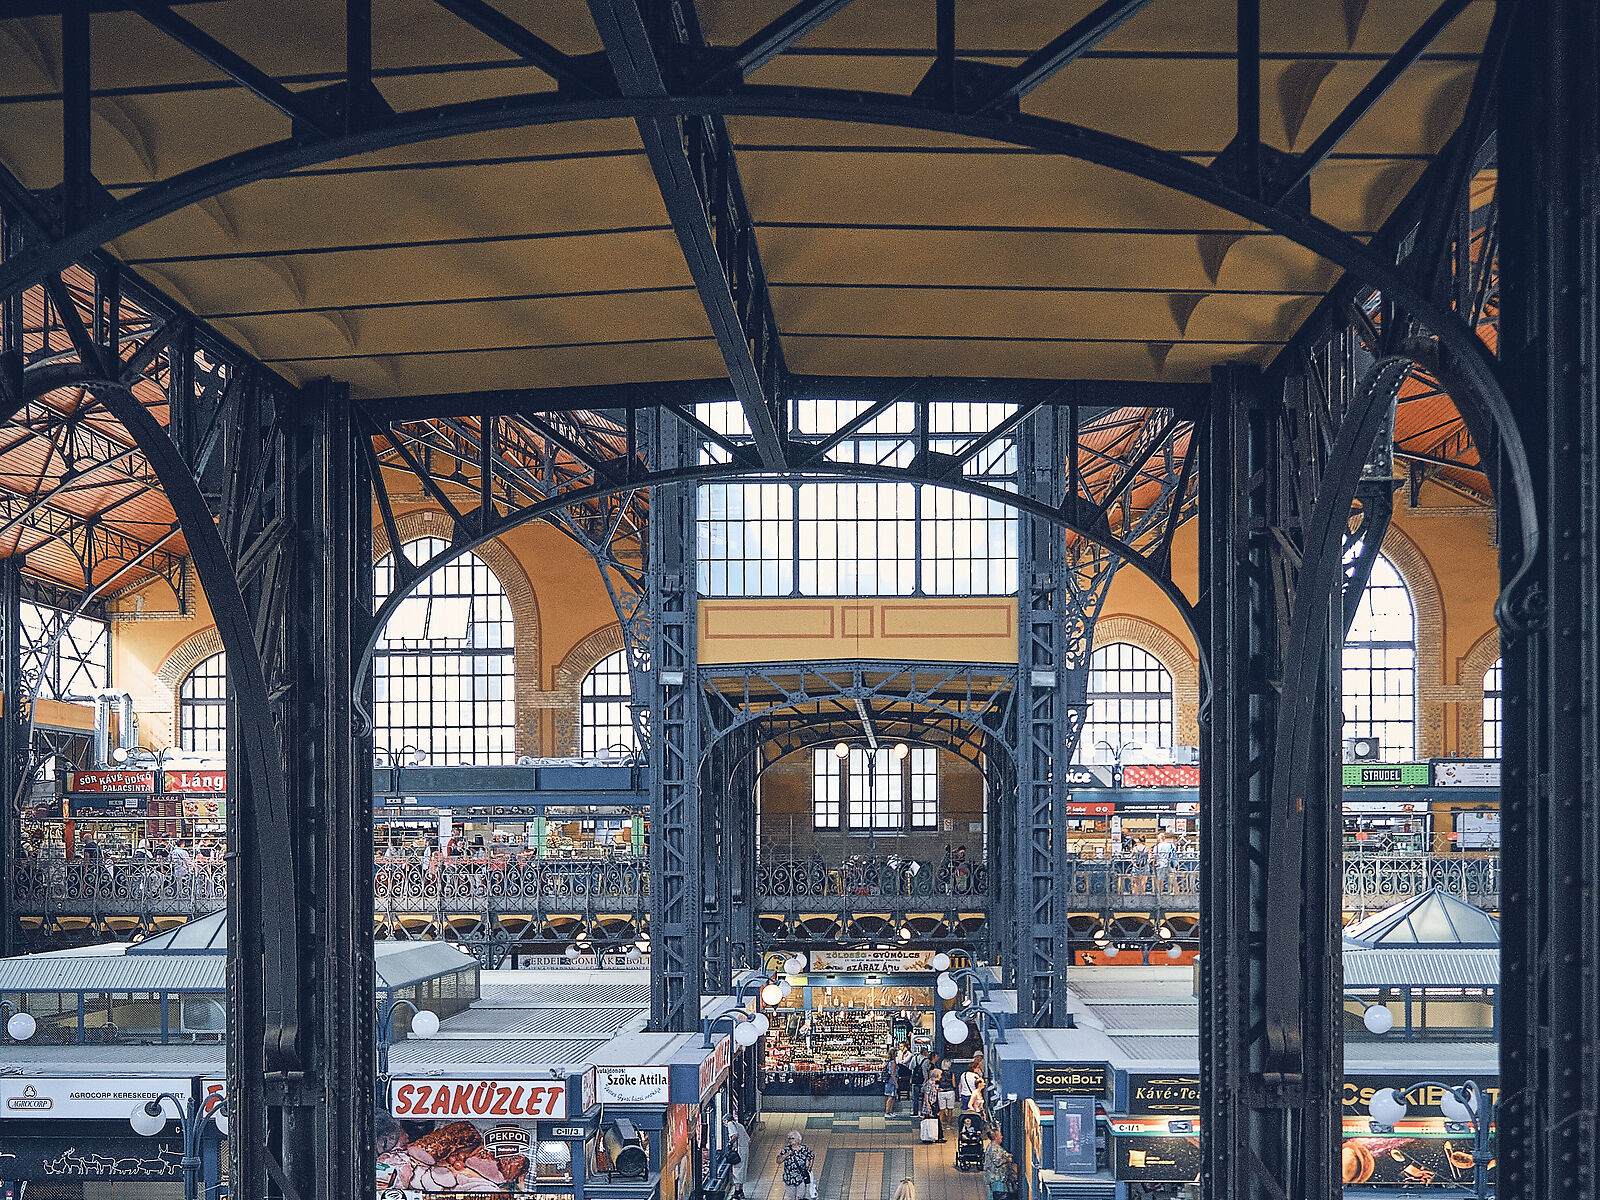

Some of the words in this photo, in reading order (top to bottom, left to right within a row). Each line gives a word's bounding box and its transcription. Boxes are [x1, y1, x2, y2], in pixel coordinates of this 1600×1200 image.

[79, 775, 98, 786] SÖR
[99, 772, 123, 785] KÁVÉ
[1363, 770, 1401, 781] STRUDEL
[826, 951, 867, 959] ZÖLDSÉG
[872, 951, 920, 959] GYÜMÖLCS
[846, 962, 880, 972] SZÁRAZ
[607, 1074, 637, 1086] Szőke
[639, 1074, 668, 1086] Attila
[395, 1081, 565, 1116] SZAKÜZLET
[1135, 1086, 1172, 1100] Kávé
[1342, 1083, 1500, 1106] CSKIBT
[11, 1100, 48, 1108] AGROCORP
[489, 1131, 529, 1143] PEKPOL
